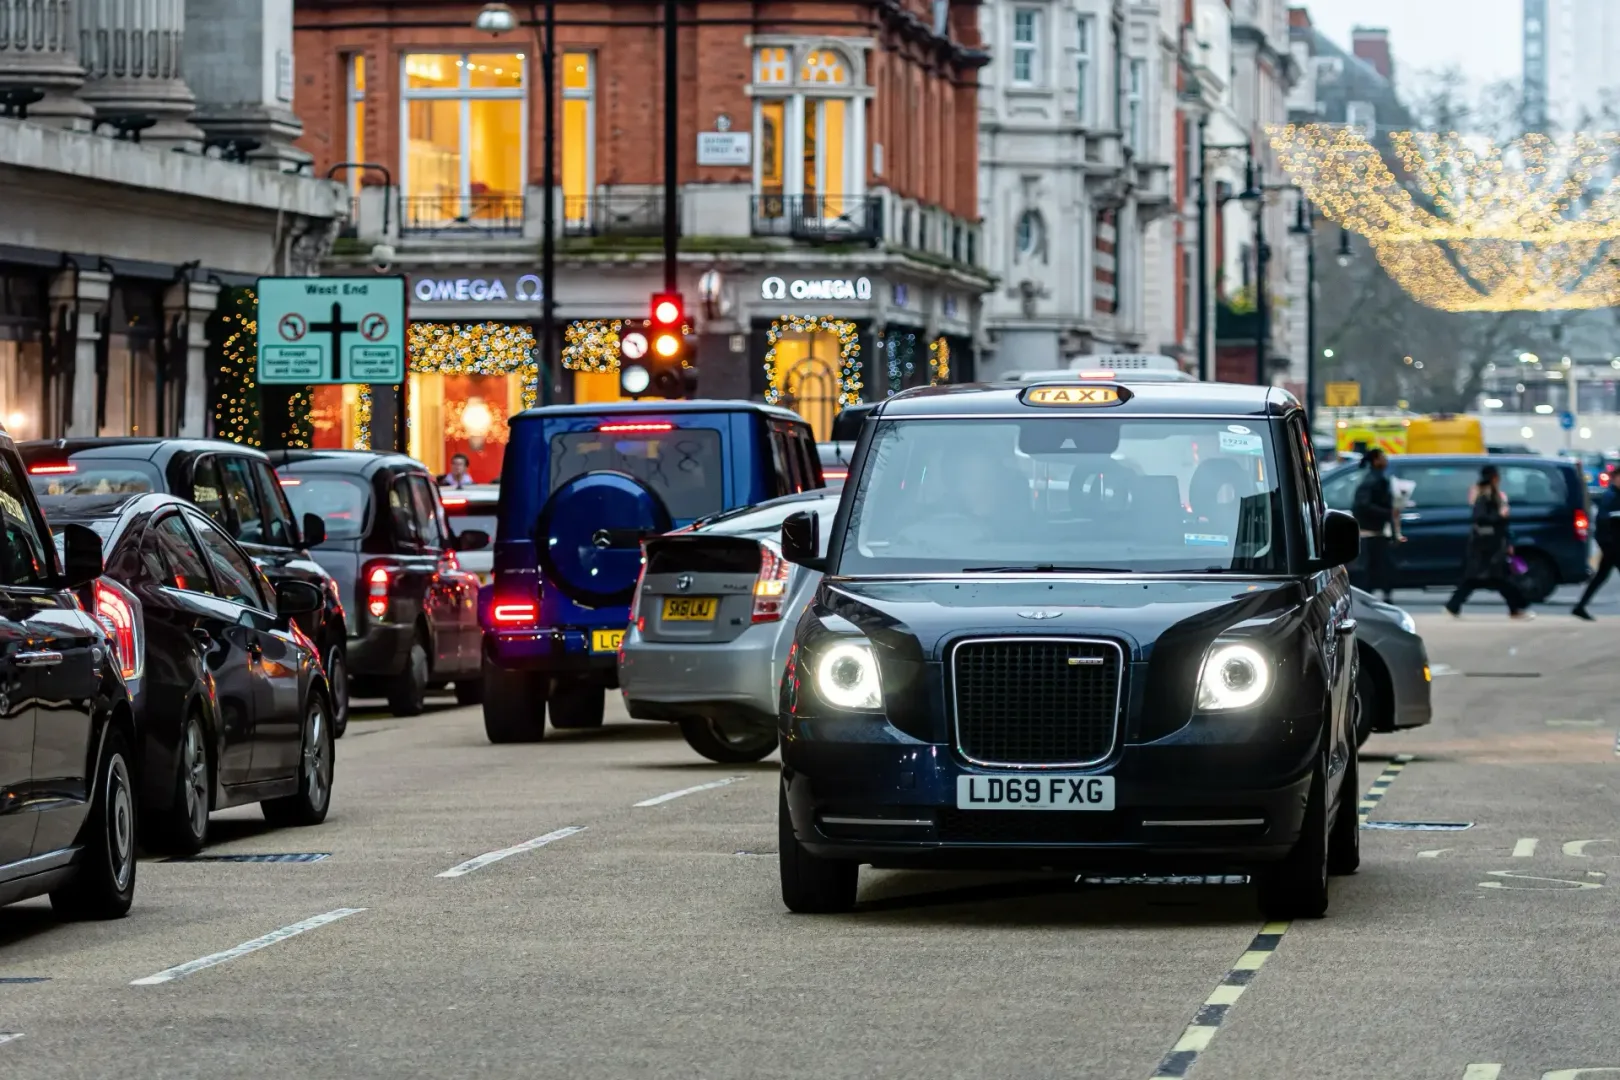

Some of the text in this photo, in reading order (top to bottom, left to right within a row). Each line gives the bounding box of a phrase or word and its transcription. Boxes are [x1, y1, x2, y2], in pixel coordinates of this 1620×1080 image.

[304, 283, 368, 295] West End
[415, 279, 508, 301] OMEGA
[790, 279, 856, 299] OMEGA
[1037, 390, 1109, 401] TAXI
[600, 634, 625, 648] LG
[969, 778, 1103, 804] LD69 FXG
